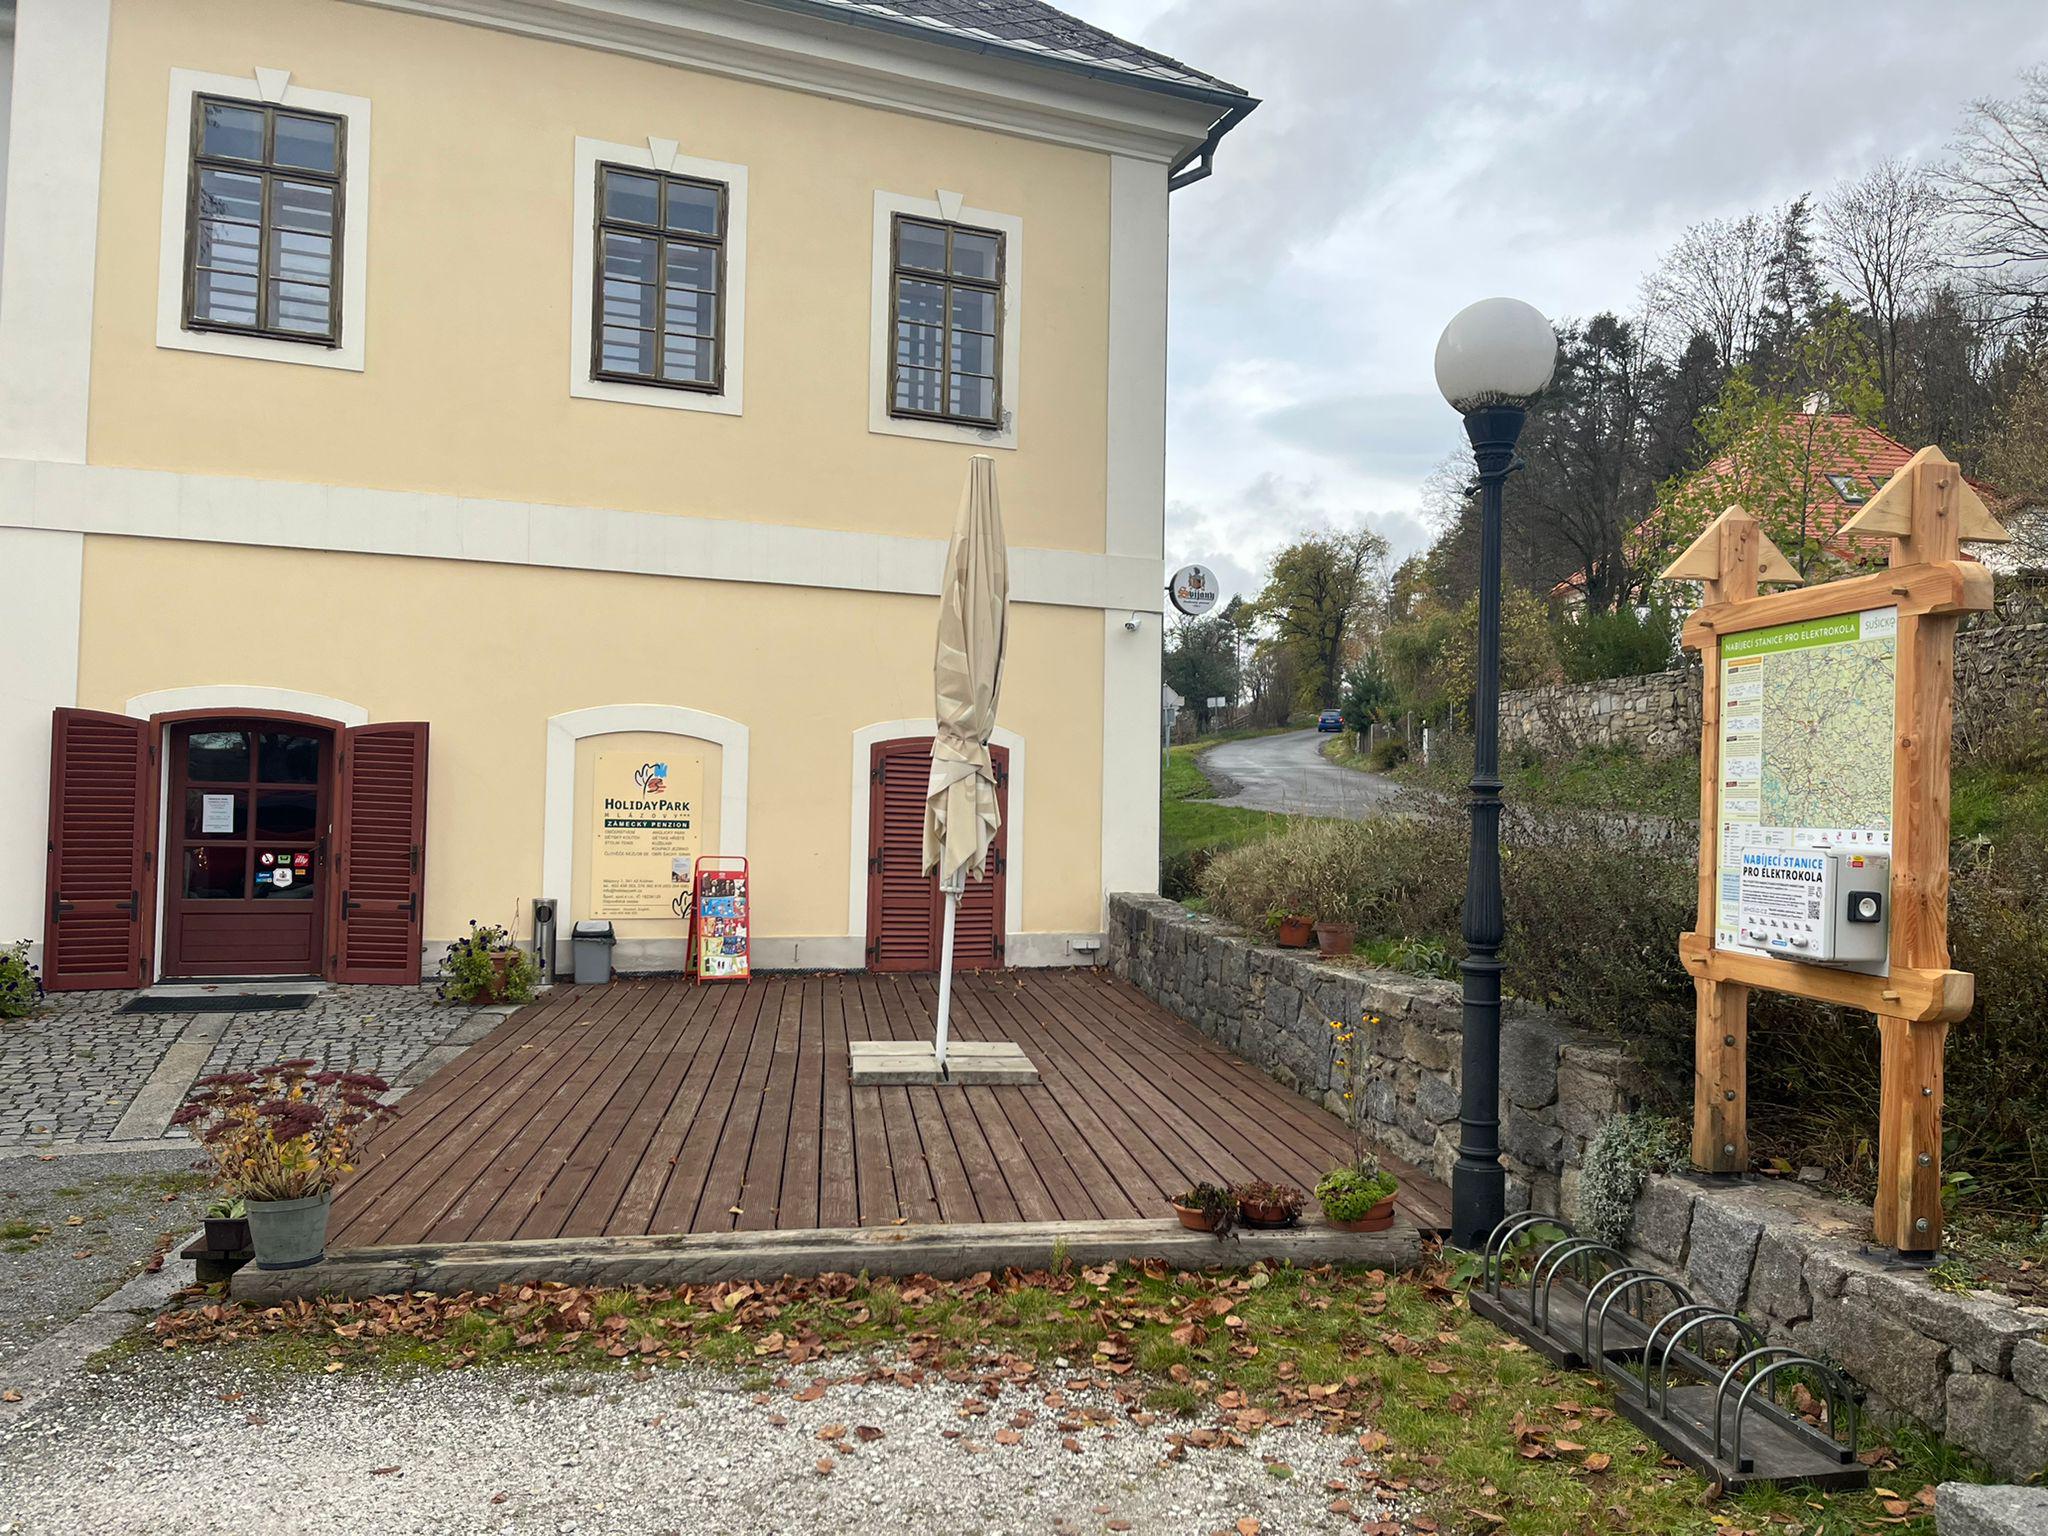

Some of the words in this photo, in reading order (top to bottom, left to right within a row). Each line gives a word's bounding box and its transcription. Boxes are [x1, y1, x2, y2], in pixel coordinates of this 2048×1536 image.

[1754, 636, 1783, 648] STANICE
[1785, 632, 1799, 643] PRO
[1801, 624, 1856, 641] ELEKTROKOLA
[1743, 853, 1781, 867] NABÍJECÍ
[1784, 857, 1823, 869] STANICE
[1743, 866, 1759, 877] PRO
[1761, 868, 1823, 882] ELEKTROKOLA
